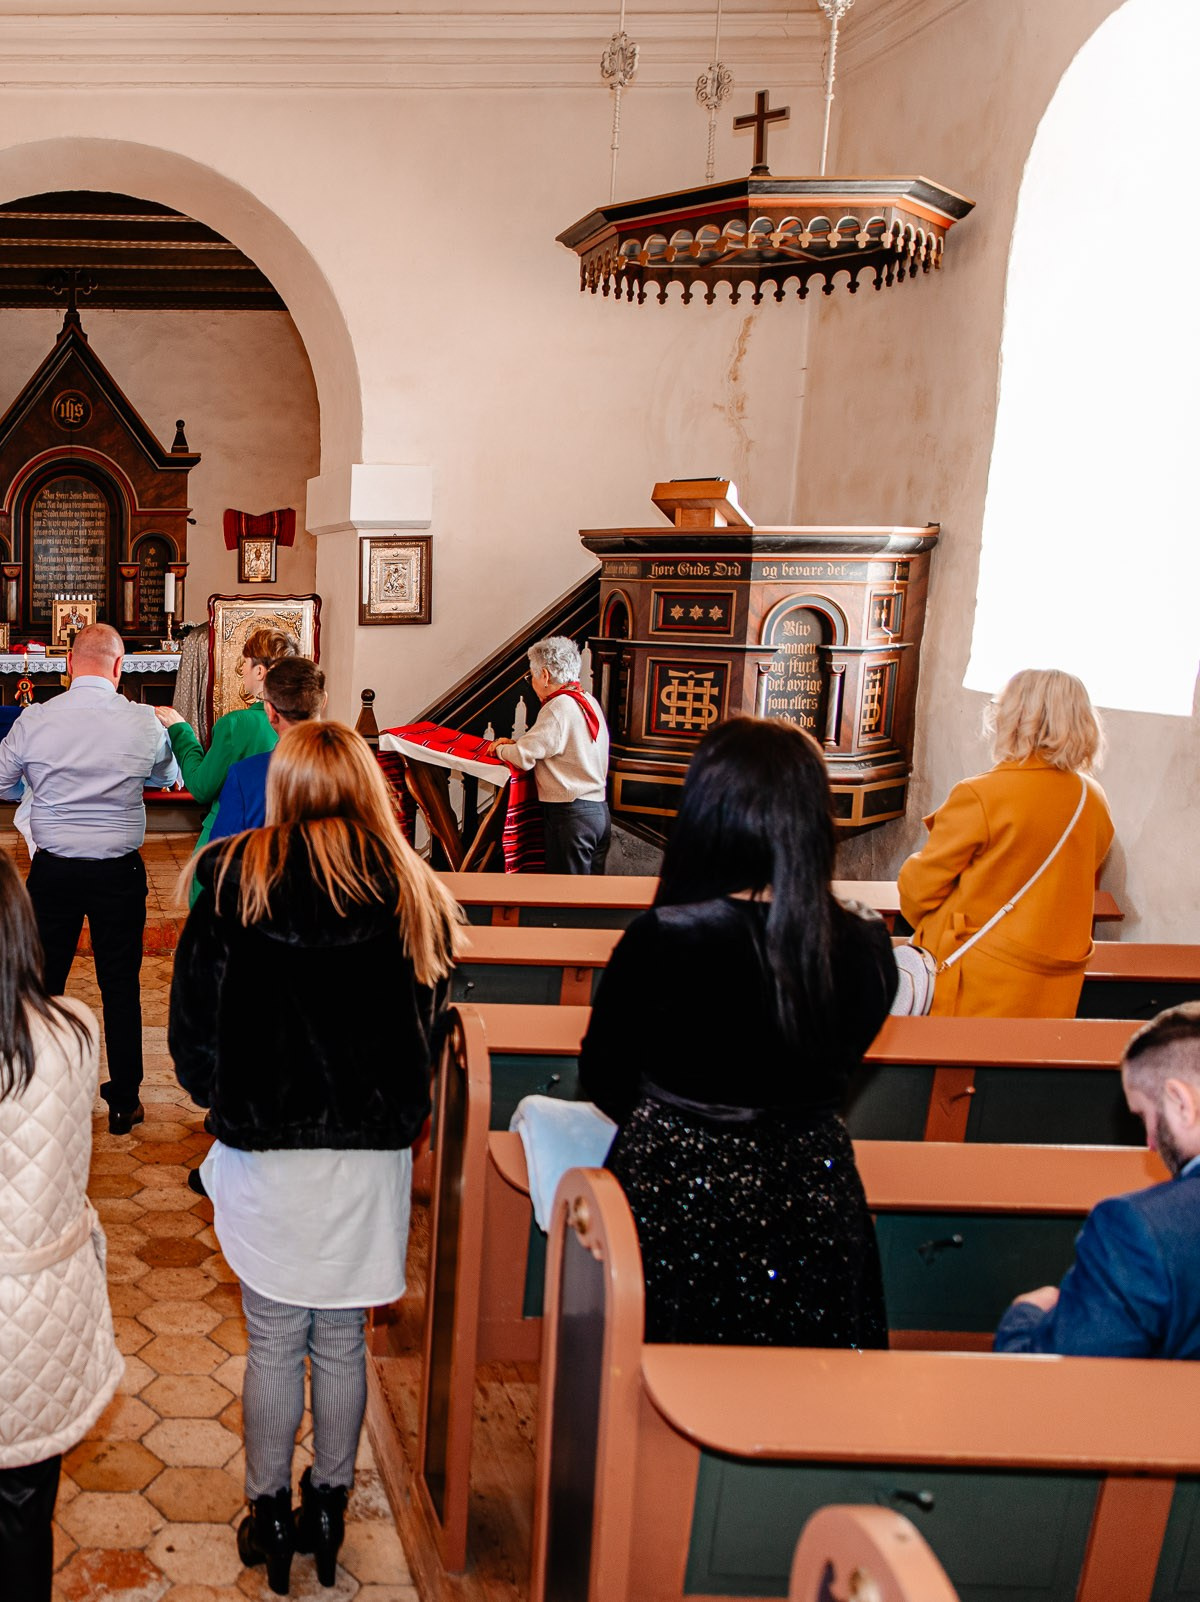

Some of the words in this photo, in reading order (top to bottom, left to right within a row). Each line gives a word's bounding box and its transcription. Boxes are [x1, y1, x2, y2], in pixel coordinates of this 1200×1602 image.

[677, 562, 711, 577] Guds
[712, 562, 742, 577] Ord
[761, 564, 778, 579] og
[781, 563, 823, 576] bevare
[783, 620, 811, 636] Bliv
[771, 661, 785, 676] og
[768, 675, 787, 692] det
